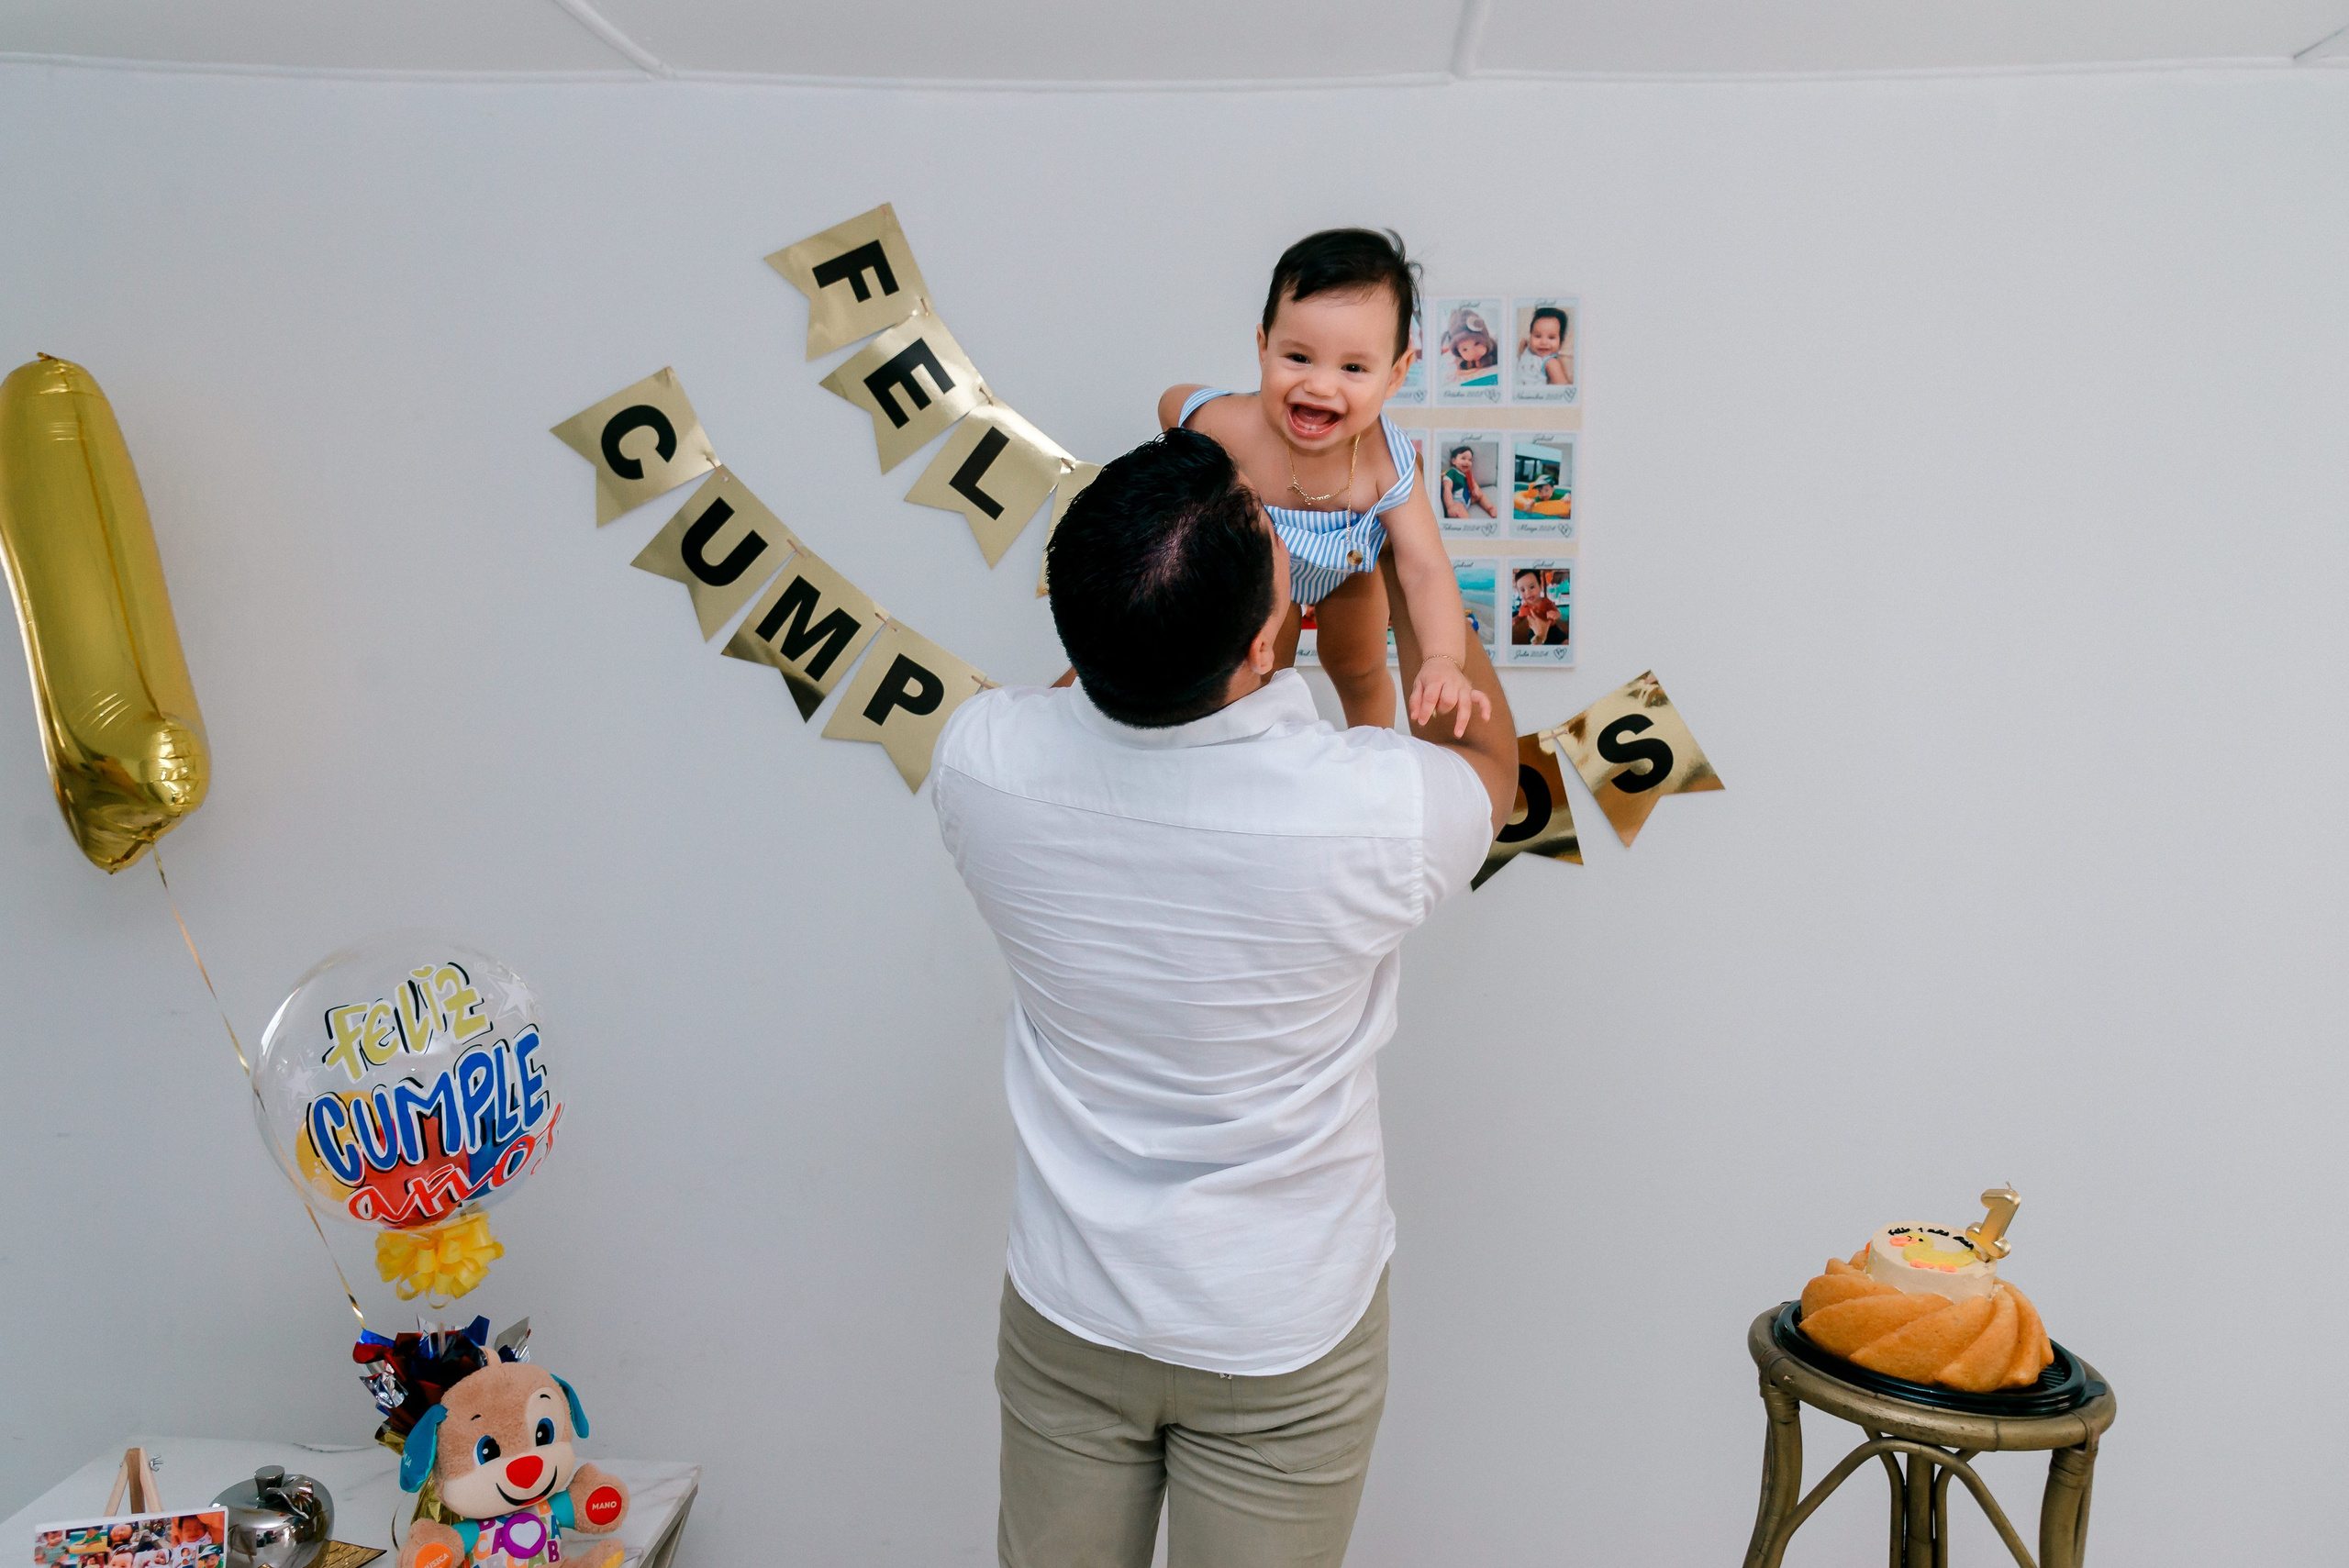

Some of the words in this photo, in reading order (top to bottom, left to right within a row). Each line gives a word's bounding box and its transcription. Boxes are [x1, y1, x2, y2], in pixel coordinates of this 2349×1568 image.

[812, 239, 1010, 520] FEL
[323, 962, 494, 1083] FELIZ
[306, 1023, 551, 1187] CUMPLE
[592, 1500, 618, 1511] MANO
